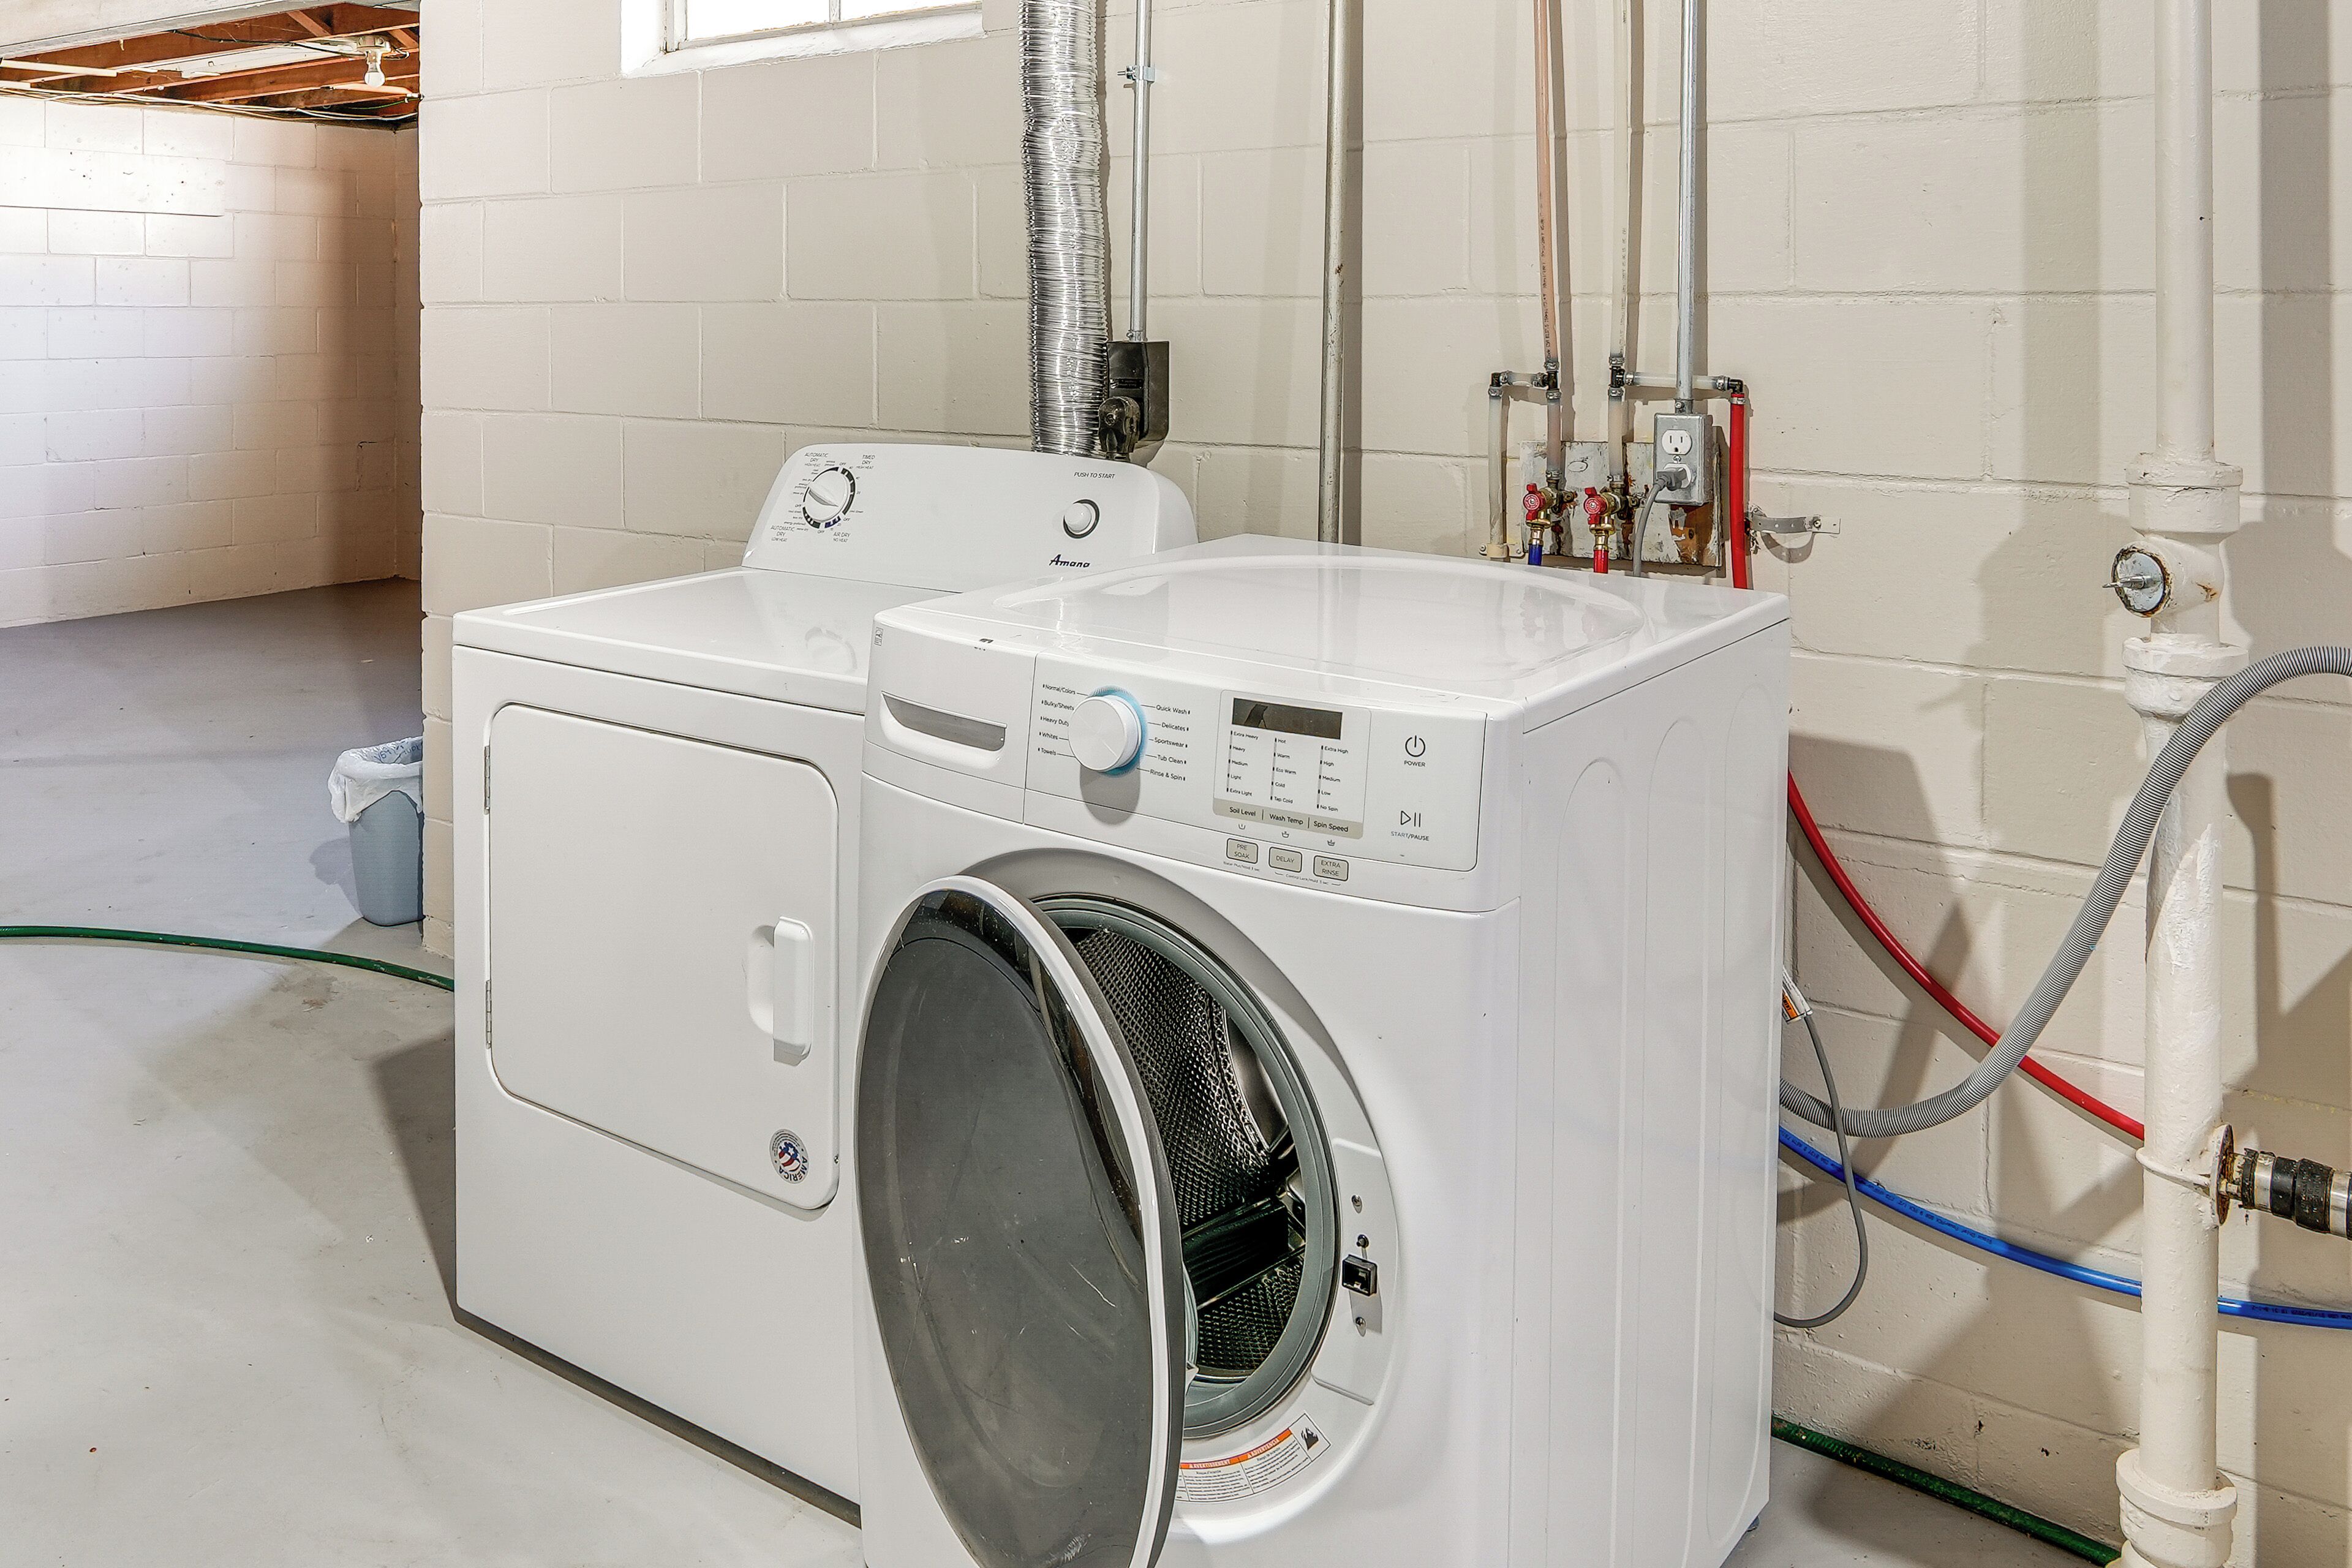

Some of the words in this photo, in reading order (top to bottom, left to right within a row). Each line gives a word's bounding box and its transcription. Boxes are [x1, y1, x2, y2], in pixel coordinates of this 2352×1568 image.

[1049, 554, 1090, 568] Amana
[1044, 700, 1074, 710] Bulky/Sheets
[1161, 722, 1185, 731] Delicates
[1155, 737, 1184, 747] Sportswear
[1287, 816, 1303, 825] Temp
[1329, 823, 1348, 832] Speed
[1391, 831, 1430, 841] START/PAUSE
[1321, 860, 1341, 869] EXTRA
[779, 1156, 808, 1181] AMERICA
